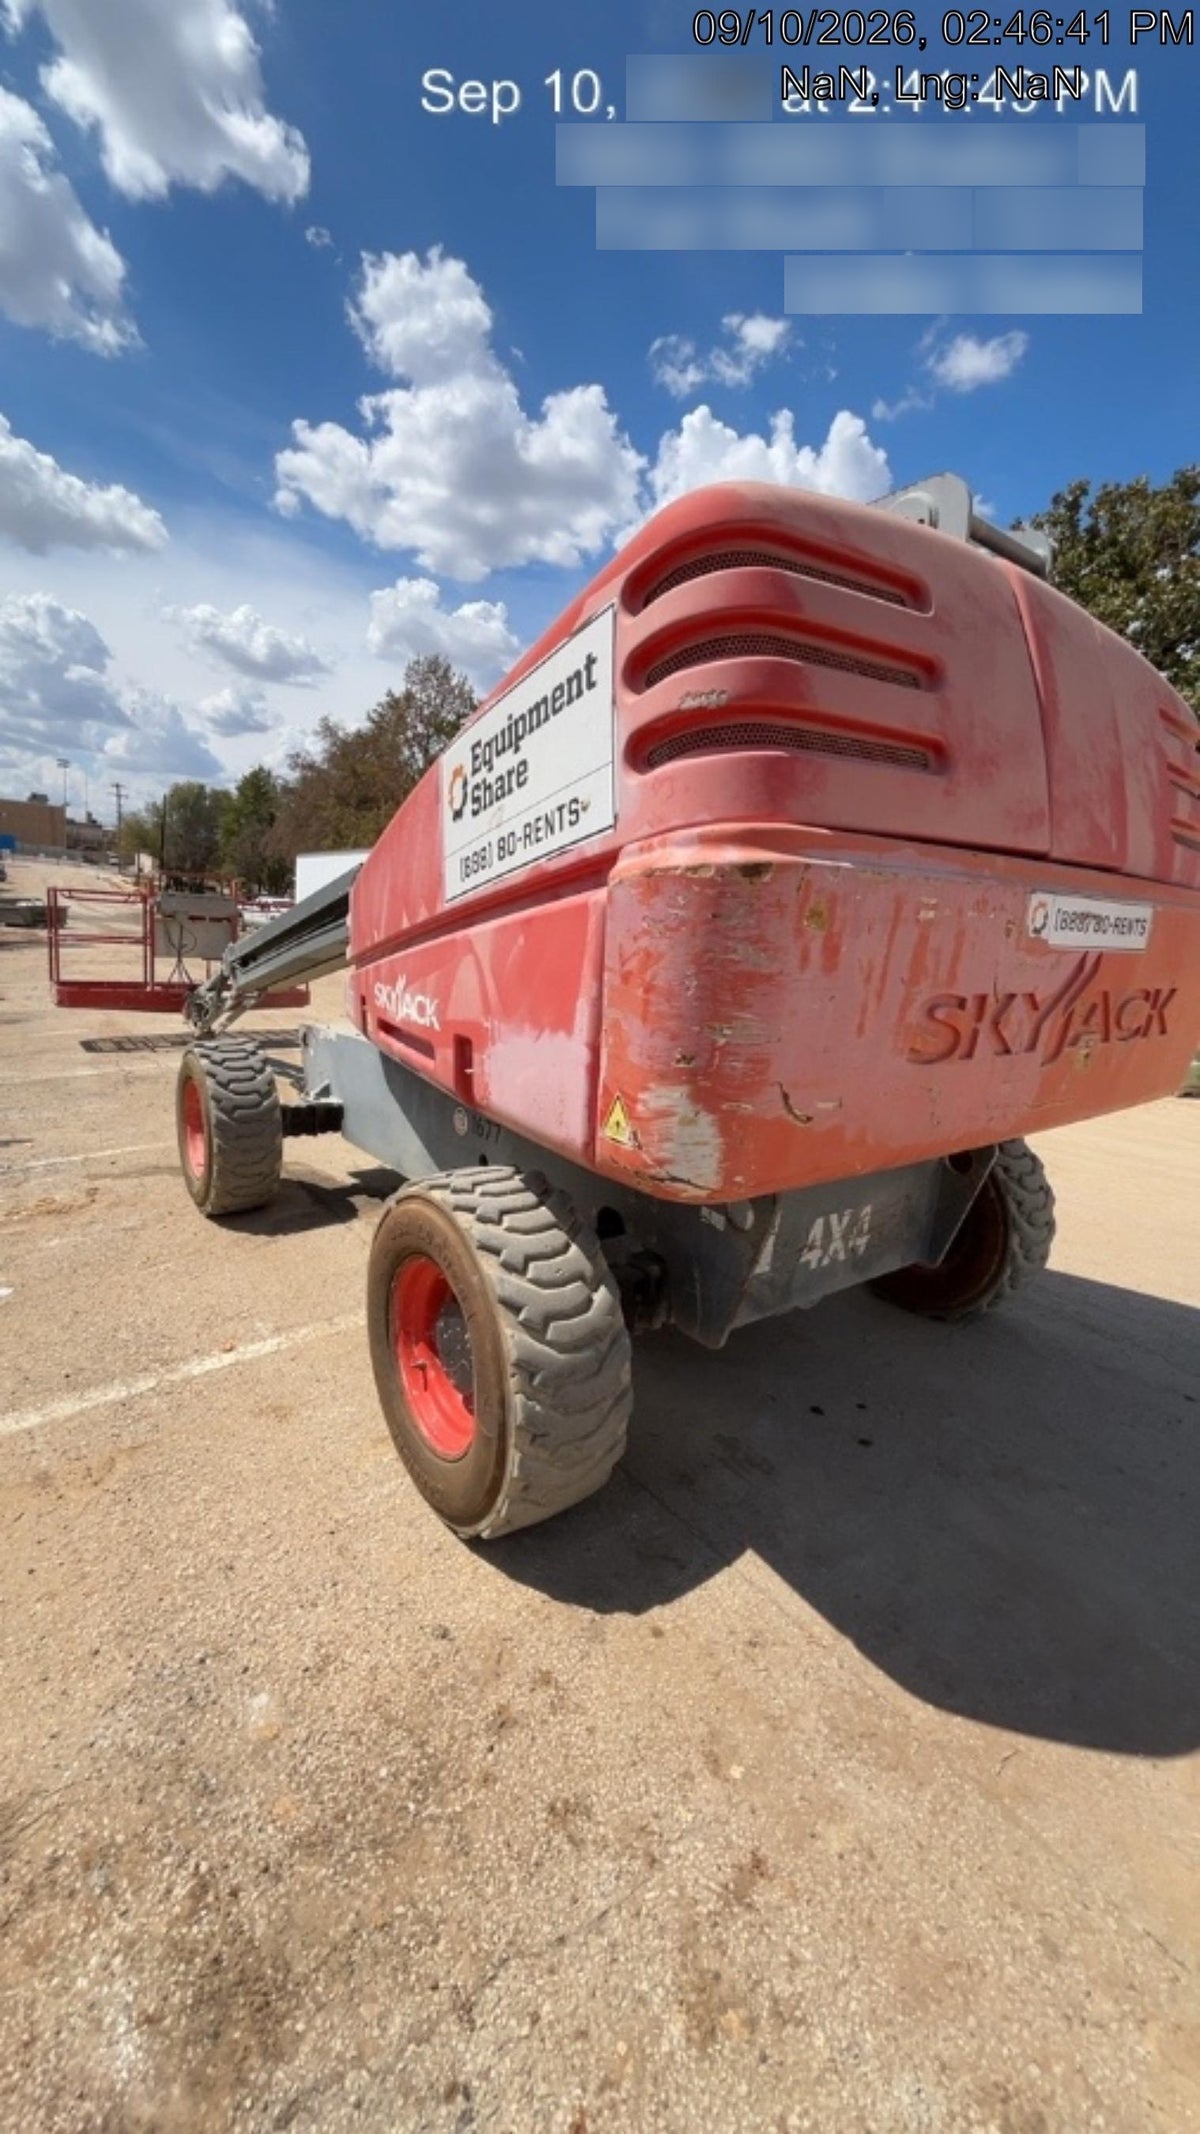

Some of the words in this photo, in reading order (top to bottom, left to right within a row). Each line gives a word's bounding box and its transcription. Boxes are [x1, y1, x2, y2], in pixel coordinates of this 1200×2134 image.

[470, 652, 598, 774] Equipment
[470, 758, 529, 817] Share
[497, 797, 580, 861] 80-RENTS
[373, 974, 440, 1031] SKYJACK
[906, 950, 1177, 1067] SKYJACK
[800, 1204, 872, 1270] 4X4
